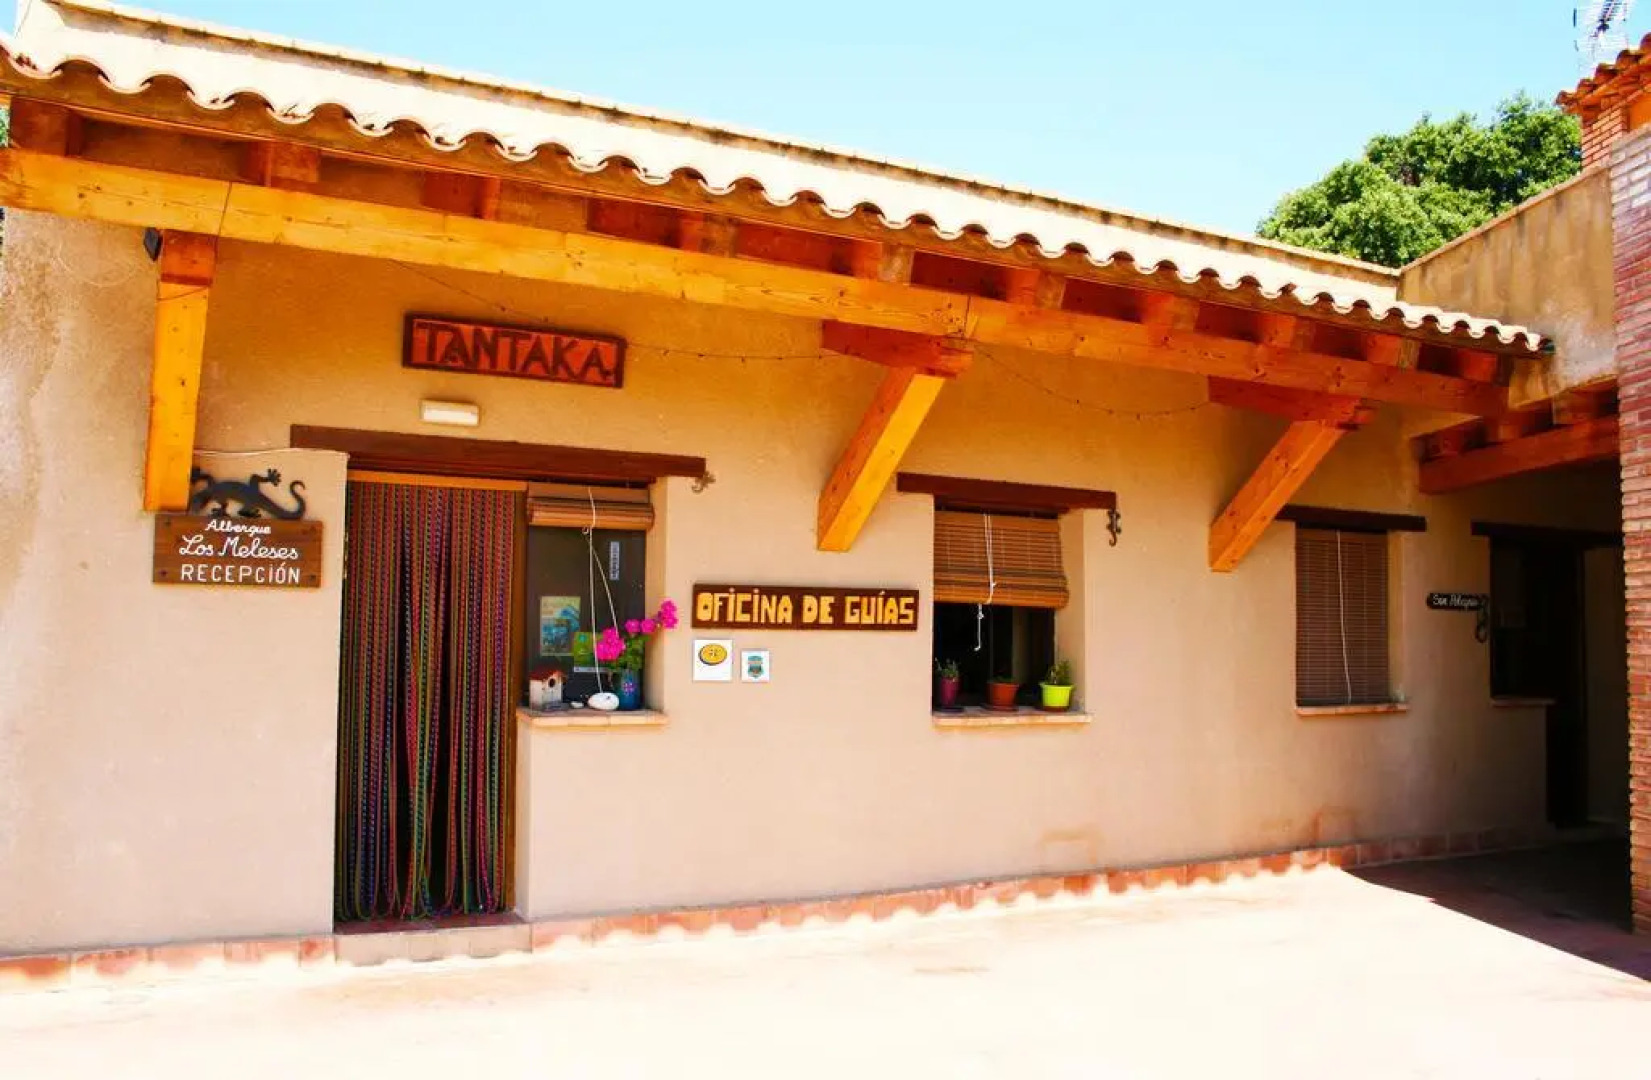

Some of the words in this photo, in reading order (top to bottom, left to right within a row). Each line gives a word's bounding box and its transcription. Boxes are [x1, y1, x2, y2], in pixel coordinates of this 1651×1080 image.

[415, 321, 611, 381] TANTAKA
[205, 518, 272, 537] Albergue
[179, 534, 214, 557] Los
[218, 536, 299, 560] Meleses
[181, 562, 301, 584] RECEPCIÓN
[695, 588, 794, 625] OFICINA
[802, 595, 835, 624] DE
[844, 590, 915, 625] GUÍAS
